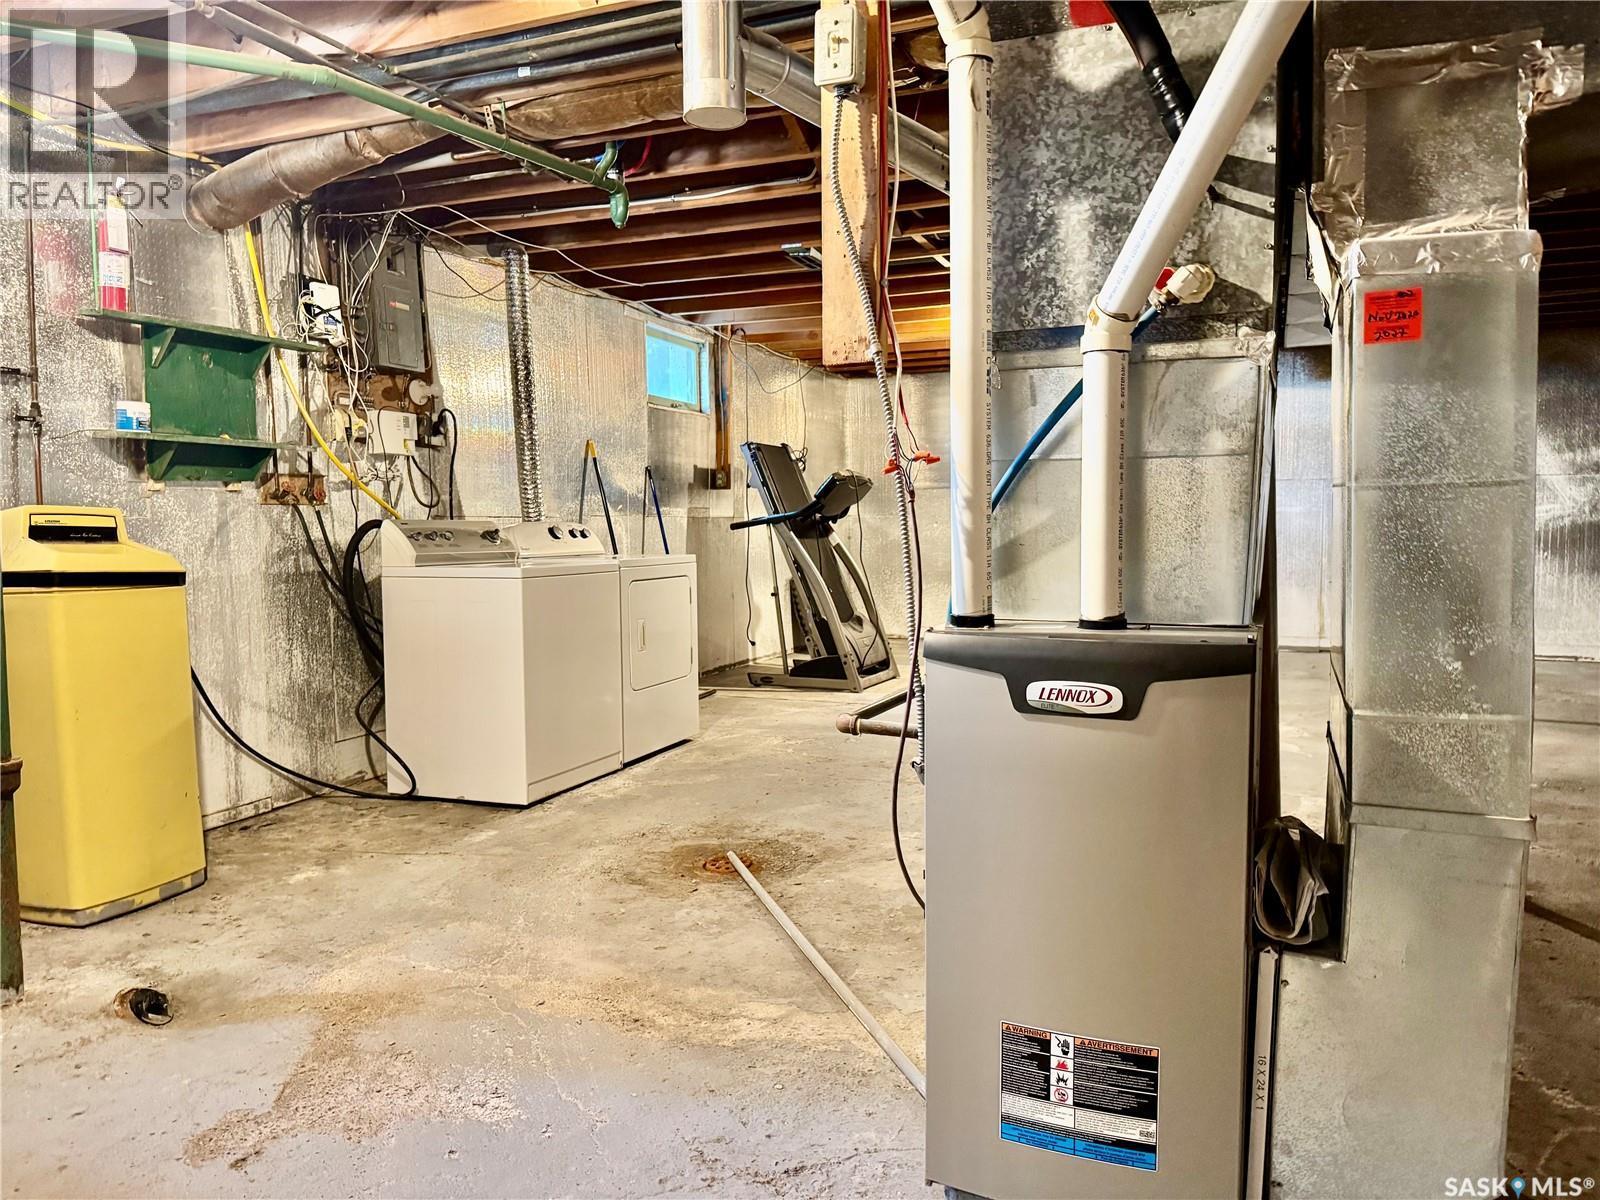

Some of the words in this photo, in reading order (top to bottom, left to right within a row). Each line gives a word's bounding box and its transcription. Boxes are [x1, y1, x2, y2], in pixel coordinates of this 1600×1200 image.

[1038, 687, 1098, 704] LENNOX
[1012, 1025, 1048, 1039] WARNING
[1087, 1040, 1154, 1056] AVERTISSEMENT
[1257, 1055, 1267, 1066] 16
[1256, 1068, 1266, 1077] X
[1256, 1079, 1266, 1091] 24
[1255, 1093, 1265, 1101] X
